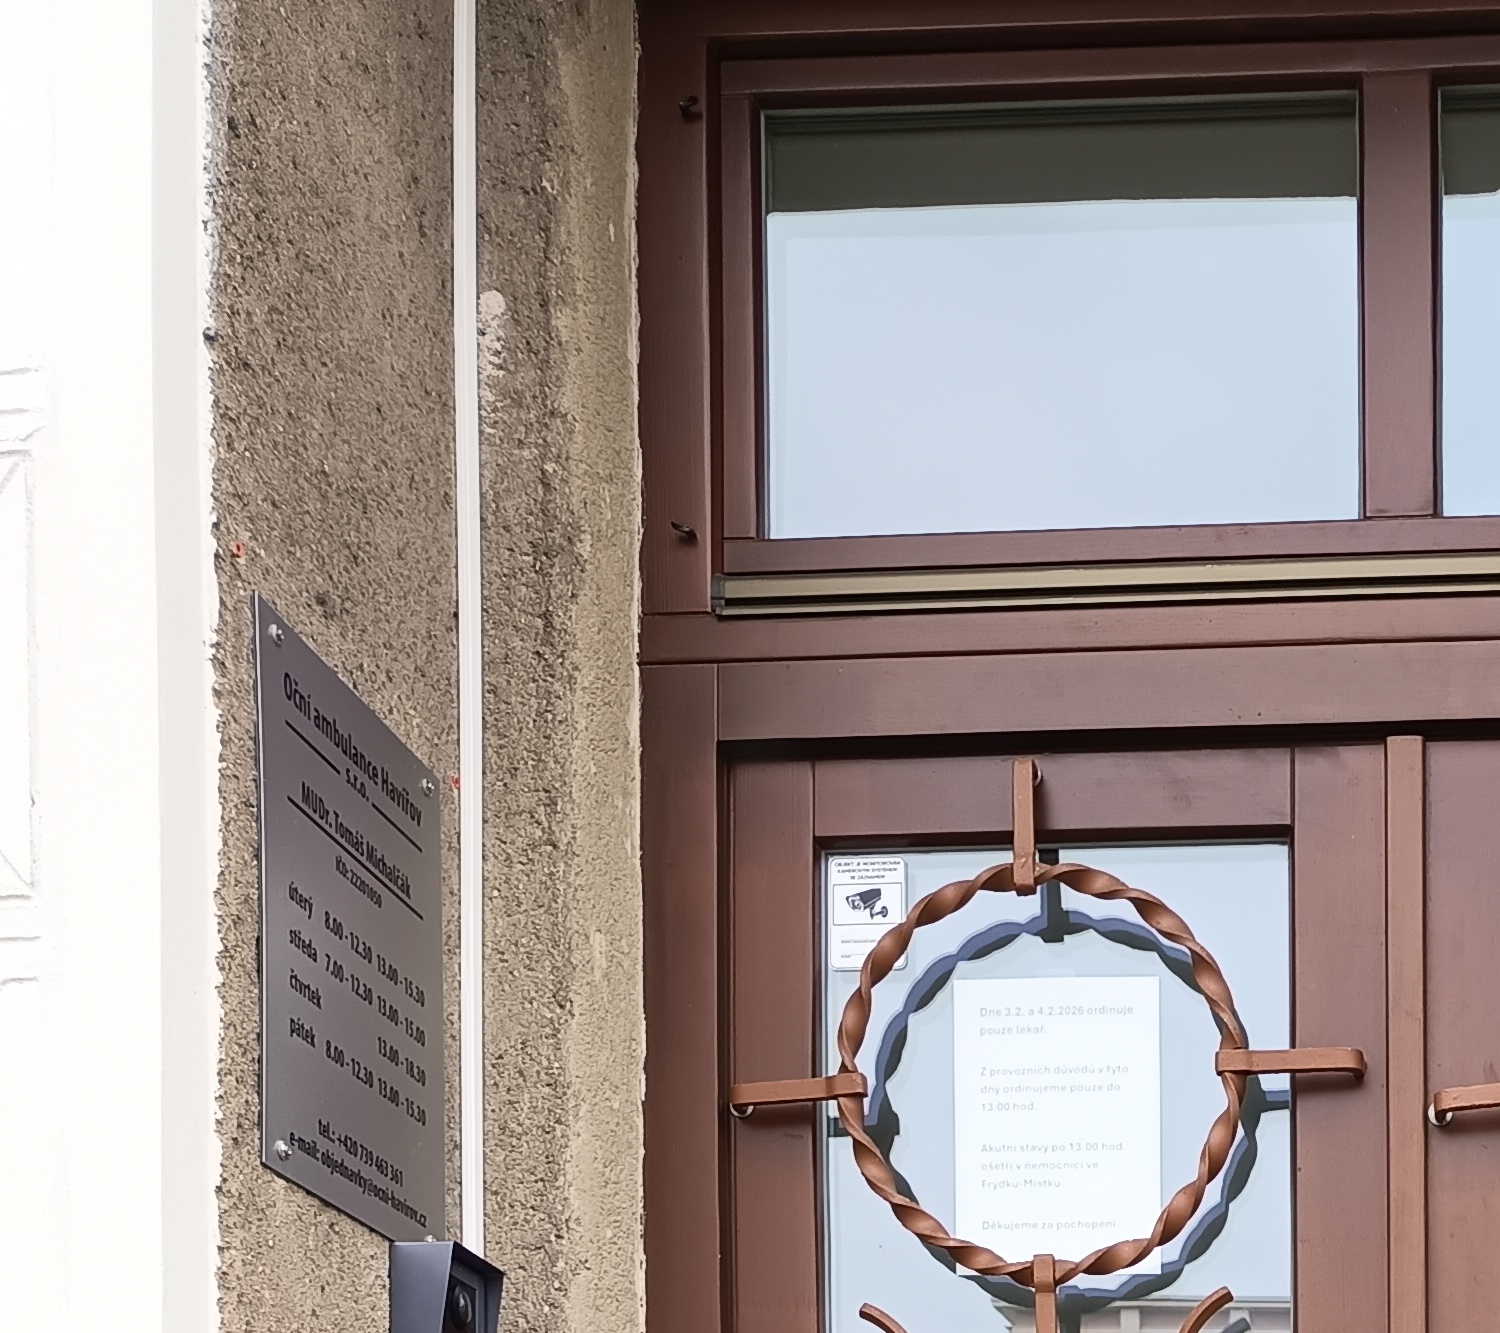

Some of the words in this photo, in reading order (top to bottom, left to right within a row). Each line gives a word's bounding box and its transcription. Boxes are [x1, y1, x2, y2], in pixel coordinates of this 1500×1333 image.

[283, 672, 311, 721] Oční
[313, 707, 379, 786] ambulance
[381, 766, 422, 827] Havířov
[346, 768, 369, 802] s.r.o.
[301, 781, 332, 828] MUDr.
[333, 810, 364, 857] Tomáš
[289, 881, 313, 920] úterý
[324, 911, 343, 941] 8.00
[350, 931, 372, 964] 12.30
[377, 954, 398, 986] 13.00
[404, 977, 425, 1007] 15.30
[290, 929, 317, 963] středa
[325, 953, 344, 983] 7.00
[351, 974, 373, 1005] 12.30
[377, 995, 399, 1026] 13.00
[404, 1017, 425, 1047] 15.00
[290, 968, 322, 1010] čtvrtek
[377, 1036, 399, 1067] 13.00
[980, 1006, 1002, 1016] Dne
[1004, 1006, 1025, 1016] 3.2.
[1037, 1005, 1085, 1015] 4.2.2026
[1086, 1004, 1134, 1015] ordinuje
[980, 1025, 1013, 1035] pouze
[290, 1017, 316, 1048] pátek
[325, 1039, 345, 1068] 8.00
[350, 1058, 374, 1089] 12.30
[378, 1077, 400, 1108] 13.00
[405, 1097, 426, 1126] 15.30
[980, 1066, 987, 1075] Z
[1097, 1065, 1103, 1073] v
[1106, 1064, 1129, 1074] tyto
[980, 1085, 1000, 1095] dny
[1003, 1084, 1067, 1094] ordinujeme
[1069, 1084, 1103, 1093] pouze
[1106, 1083, 1121, 1092] do
[1012, 1102, 1037, 1111] hod.
[290, 1131, 319, 1162] e-mail:
[336, 1133, 358, 1158] +420
[360, 1143, 374, 1167] 739
[390, 1164, 403, 1188] 361
[1019, 1144, 1049, 1154] stavy
[1051, 1144, 1065, 1154] po
[1016, 1162, 1021, 1170] v
[1086, 1161, 1099, 1169] ve
[1041, 1222, 1053, 1230] za
